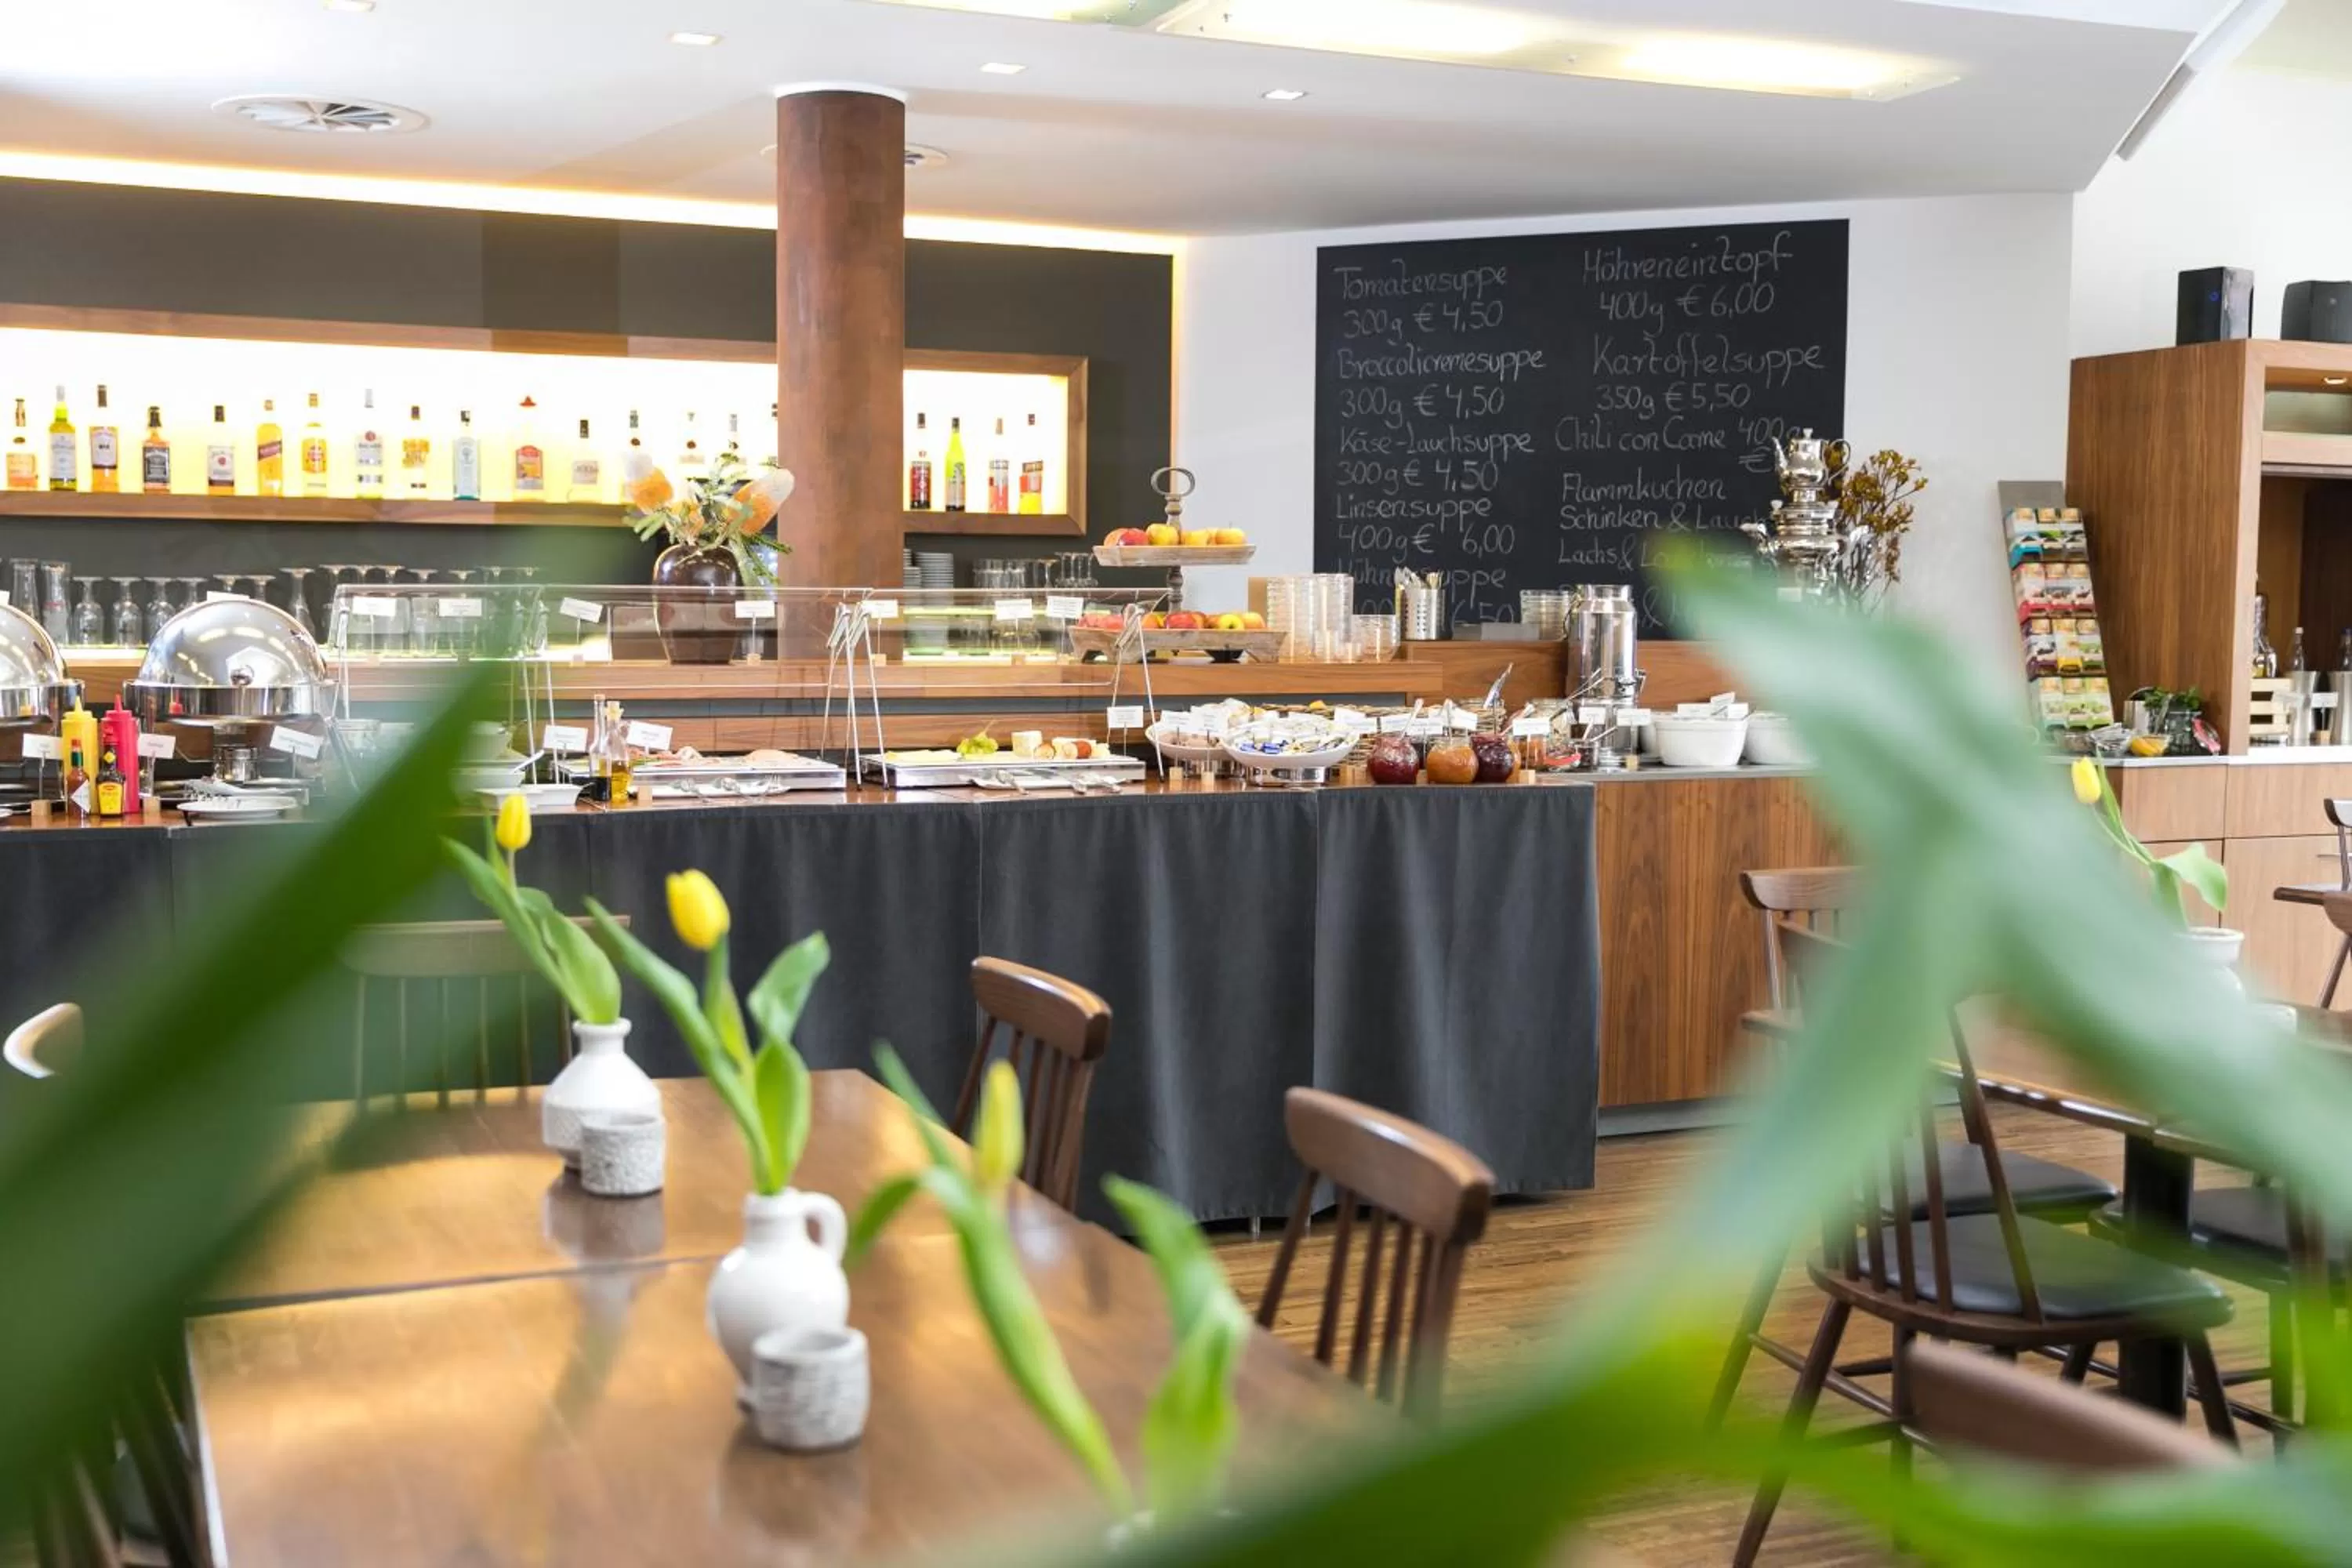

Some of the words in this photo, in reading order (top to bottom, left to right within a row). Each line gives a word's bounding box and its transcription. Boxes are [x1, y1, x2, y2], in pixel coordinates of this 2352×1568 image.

[1334, 258, 1506, 300] Tomatensuppe
[1414, 302, 1436, 332] €
[1443, 300, 1504, 332] 4,50
[1675, 284, 1706, 317] €
[1711, 281, 1775, 318] 6,00
[1338, 341, 1546, 382] Broccolicremesuppe
[1593, 332, 1824, 389] Kartoffelsuppe
[1413, 383, 1439, 417] €
[1446, 383, 1504, 419] 4,50
[1664, 381, 1686, 412] €
[1692, 382, 1751, 414] 5,50
[1555, 413, 1612, 452] Chili
[1618, 432, 1660, 452] con
[1403, 459, 1424, 487] €
[1436, 459, 1499, 493] 4,50
[1563, 463, 1726, 503] Flammkuchen
[1336, 493, 1492, 534] Linsensuppe
[1559, 503, 1661, 531] Schinken
[1412, 523, 1436, 554] €
[1462, 523, 1515, 558] 6,00
[1559, 536, 1618, 564] Lachs
